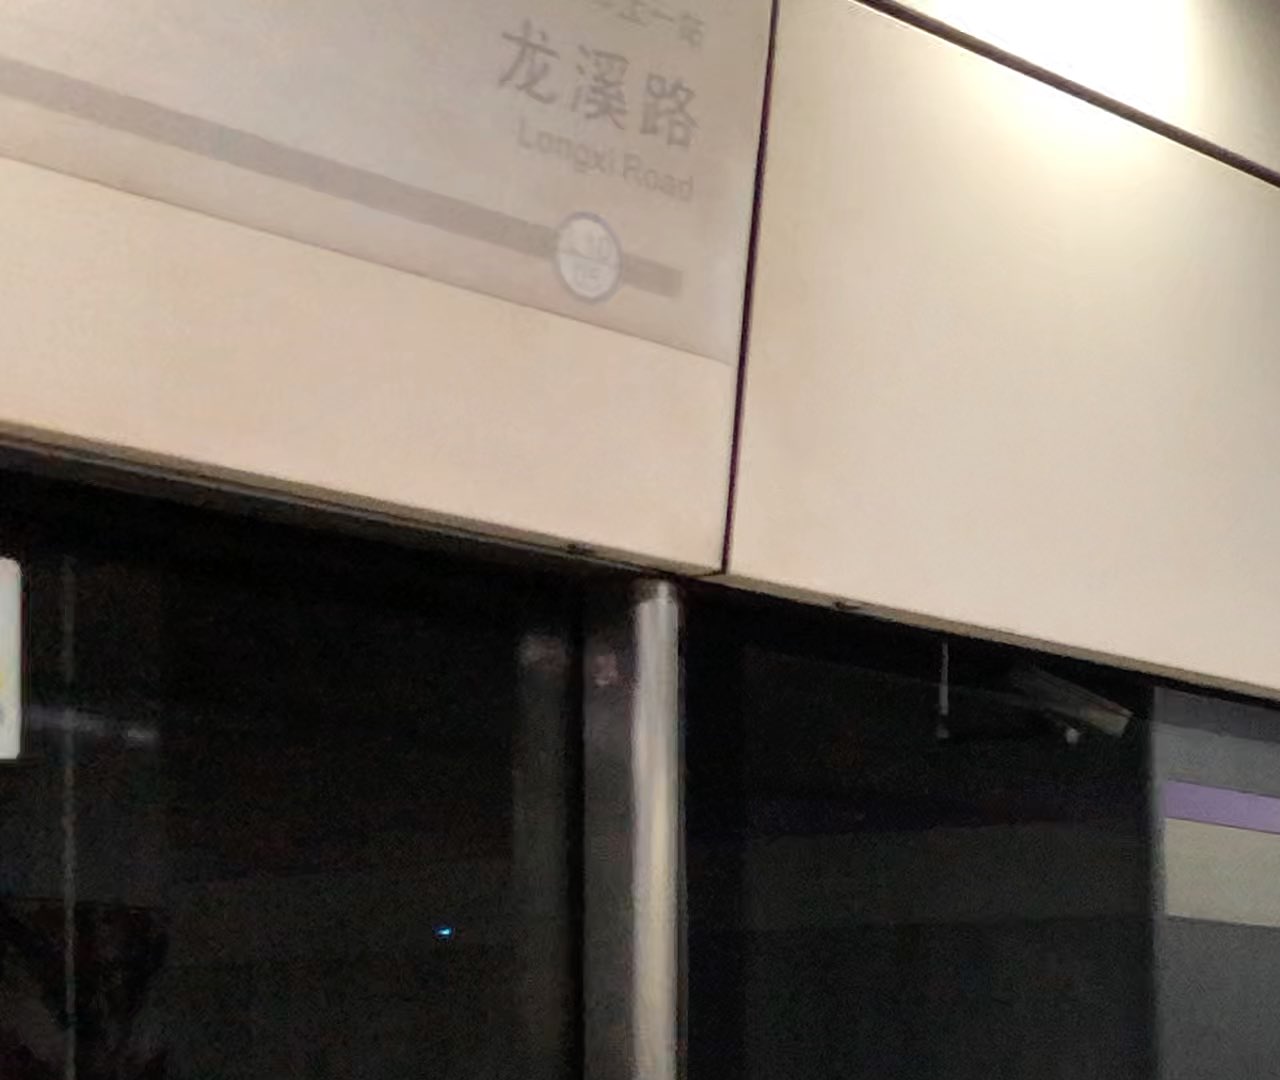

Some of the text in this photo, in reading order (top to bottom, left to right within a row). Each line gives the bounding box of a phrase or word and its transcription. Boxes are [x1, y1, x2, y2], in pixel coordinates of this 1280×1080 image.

[499, 18, 699, 148] 龙溪路
[622, 152, 694, 202] Road
